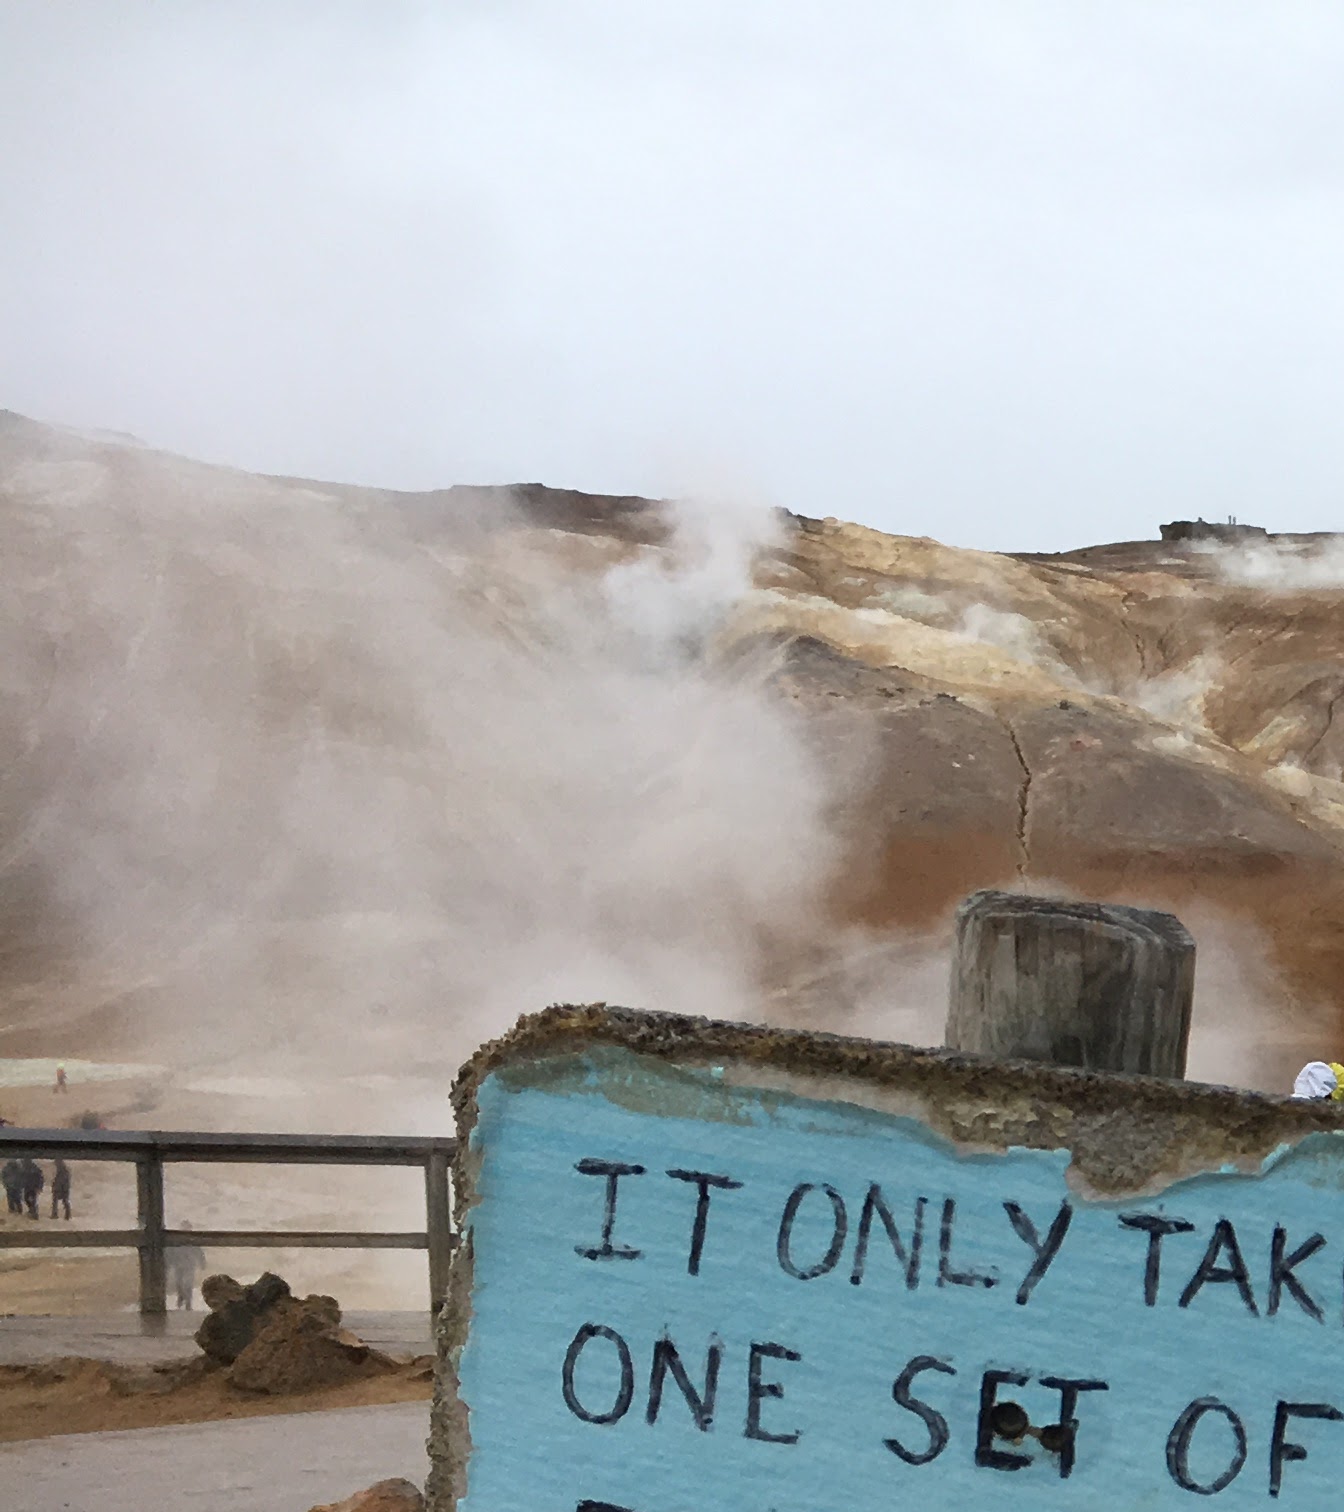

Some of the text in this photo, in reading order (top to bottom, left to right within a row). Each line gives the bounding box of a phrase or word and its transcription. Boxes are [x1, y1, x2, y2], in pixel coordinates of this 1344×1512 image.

[572, 1159, 744, 1277] IT
[776, 1181, 1075, 1306] ONLY
[561, 1323, 803, 1445] ONE
[883, 1355, 1109, 1480] SET
